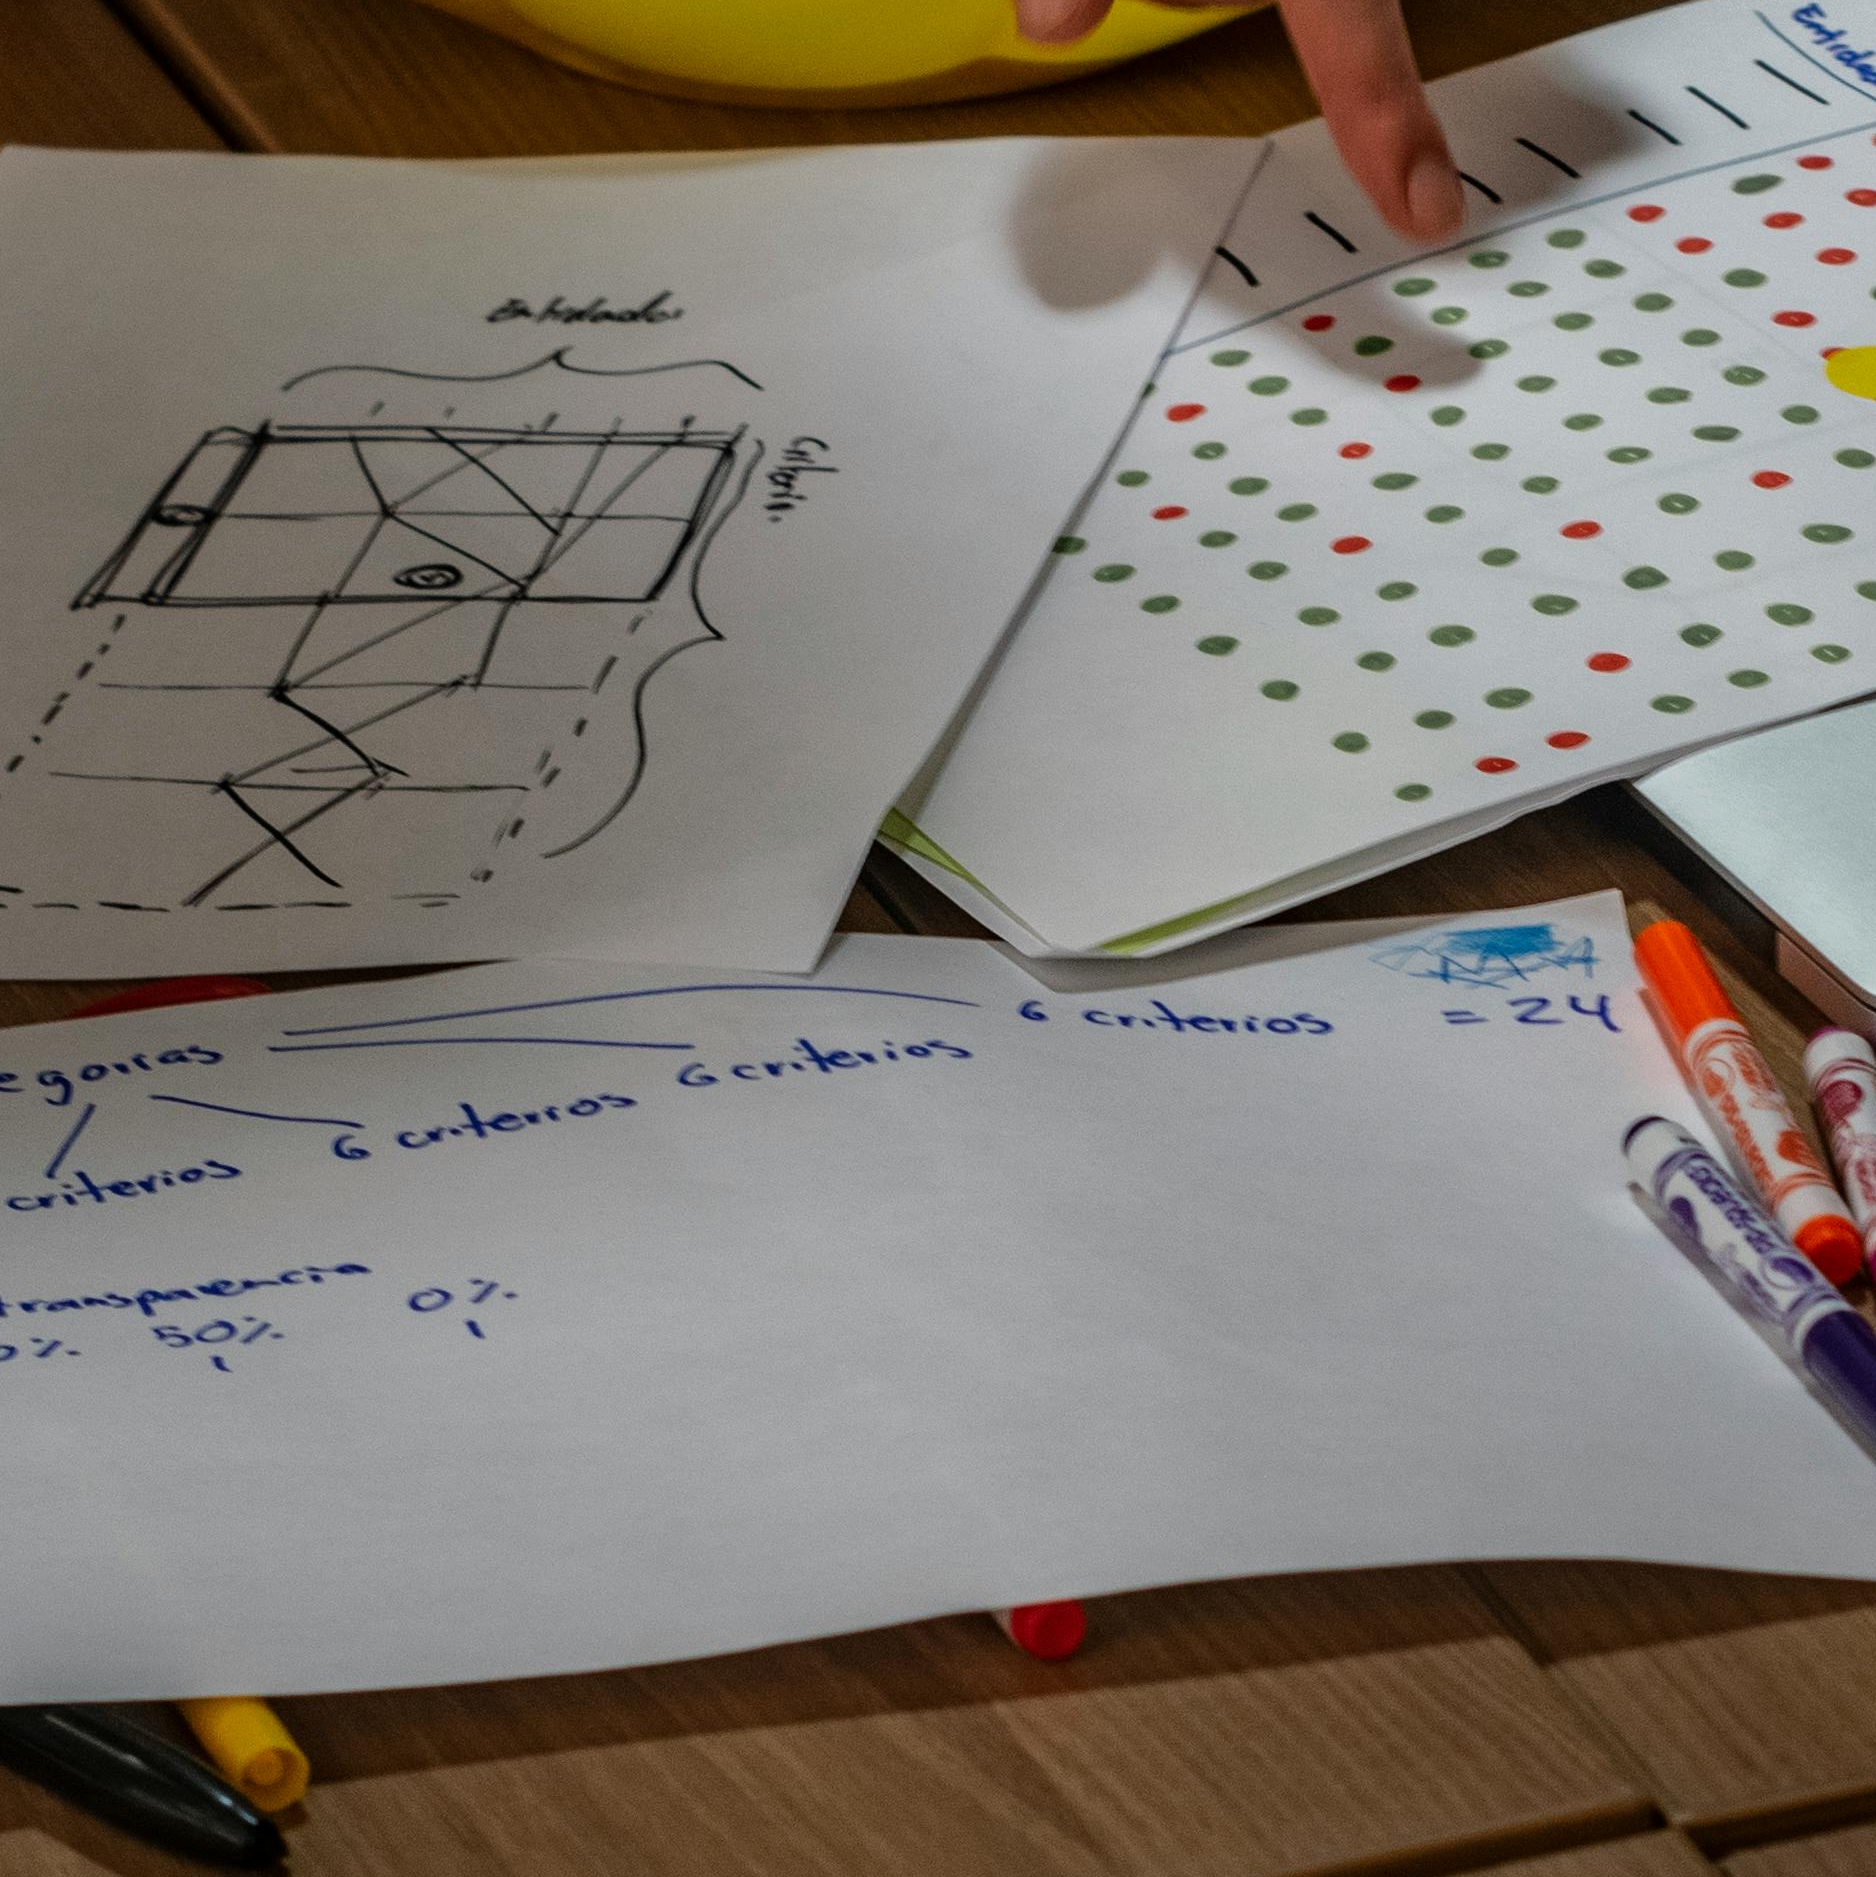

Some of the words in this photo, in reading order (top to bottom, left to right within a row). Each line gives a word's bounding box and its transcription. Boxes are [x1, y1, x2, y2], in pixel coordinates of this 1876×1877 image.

[1081, 998, 1334, 1036] criterios
[1507, 993, 1620, 1034] 24
[675, 1061, 720, 1088] 6
[730, 1037, 973, 1081] criterios
[331, 1133, 371, 1162] 6
[5, 1158, 243, 1213] criterios
